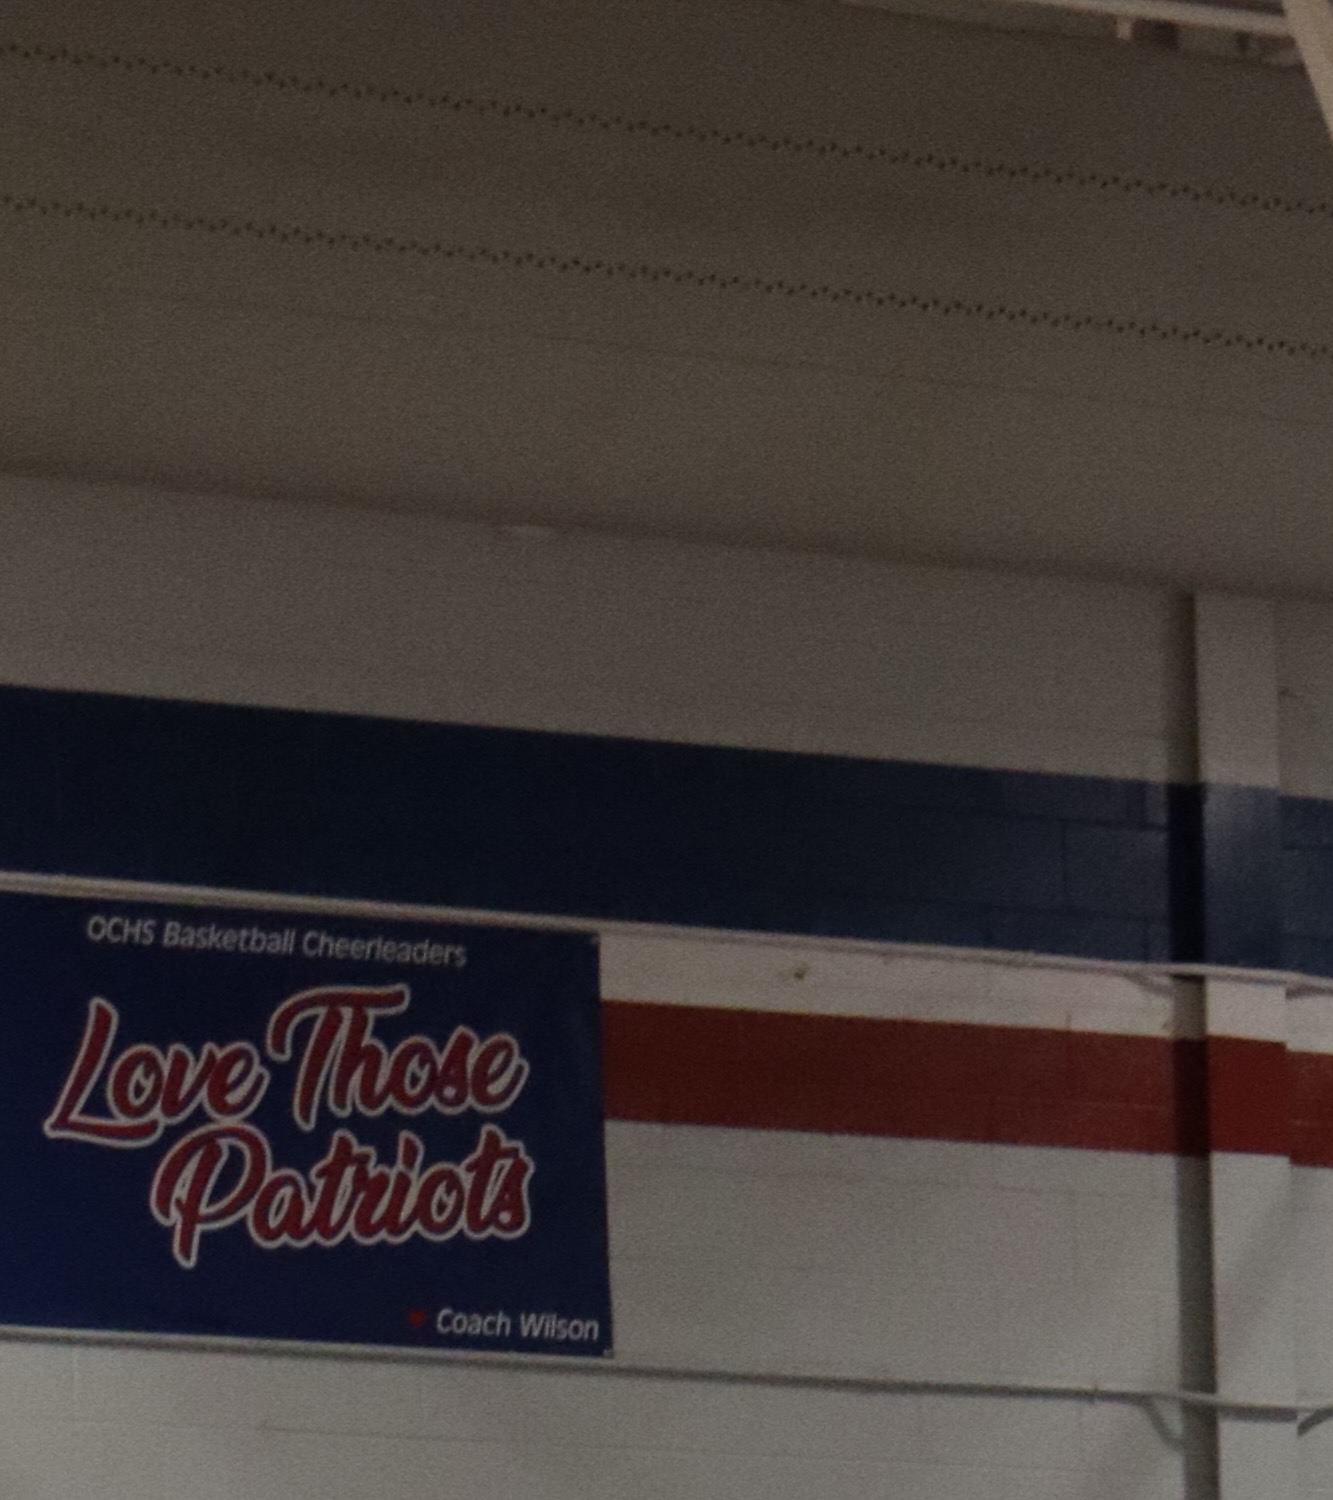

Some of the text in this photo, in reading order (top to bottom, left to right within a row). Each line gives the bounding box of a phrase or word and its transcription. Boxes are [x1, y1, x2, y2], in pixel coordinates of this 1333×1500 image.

[88, 915, 467, 968] OCHS Basketball Cheerleaders
[44, 982, 530, 1148] Love Those
[150, 1119, 533, 1270] Patriots
[436, 1306, 600, 1341] Coach Wilson
